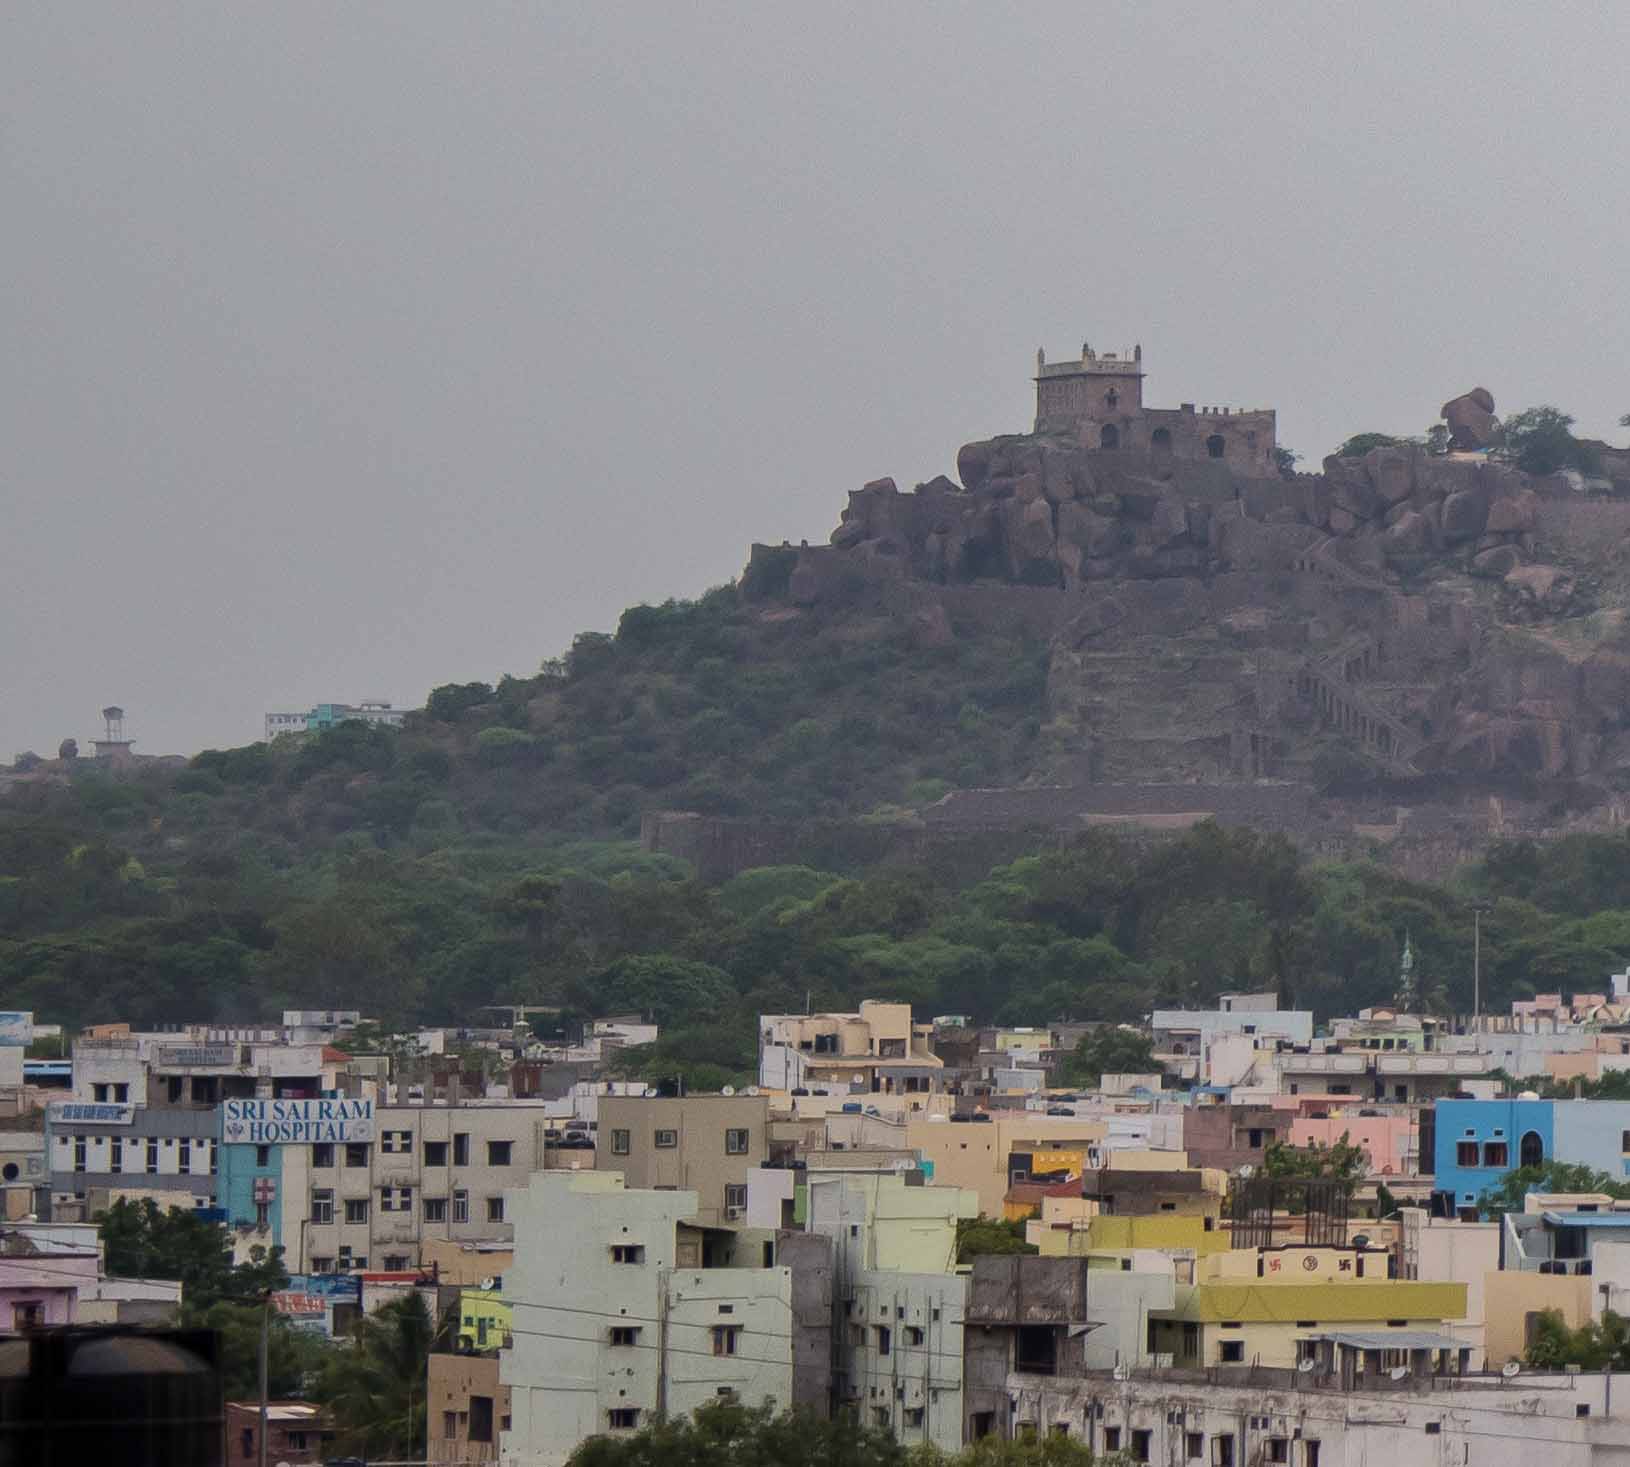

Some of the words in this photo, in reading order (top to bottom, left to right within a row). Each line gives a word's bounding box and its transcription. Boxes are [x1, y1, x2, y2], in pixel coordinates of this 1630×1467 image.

[227, 1101, 265, 1120] SRI
[272, 1101, 309, 1120] SAI
[319, 1101, 371, 1120] RAM
[250, 1121, 350, 1142] HOSPITAL
